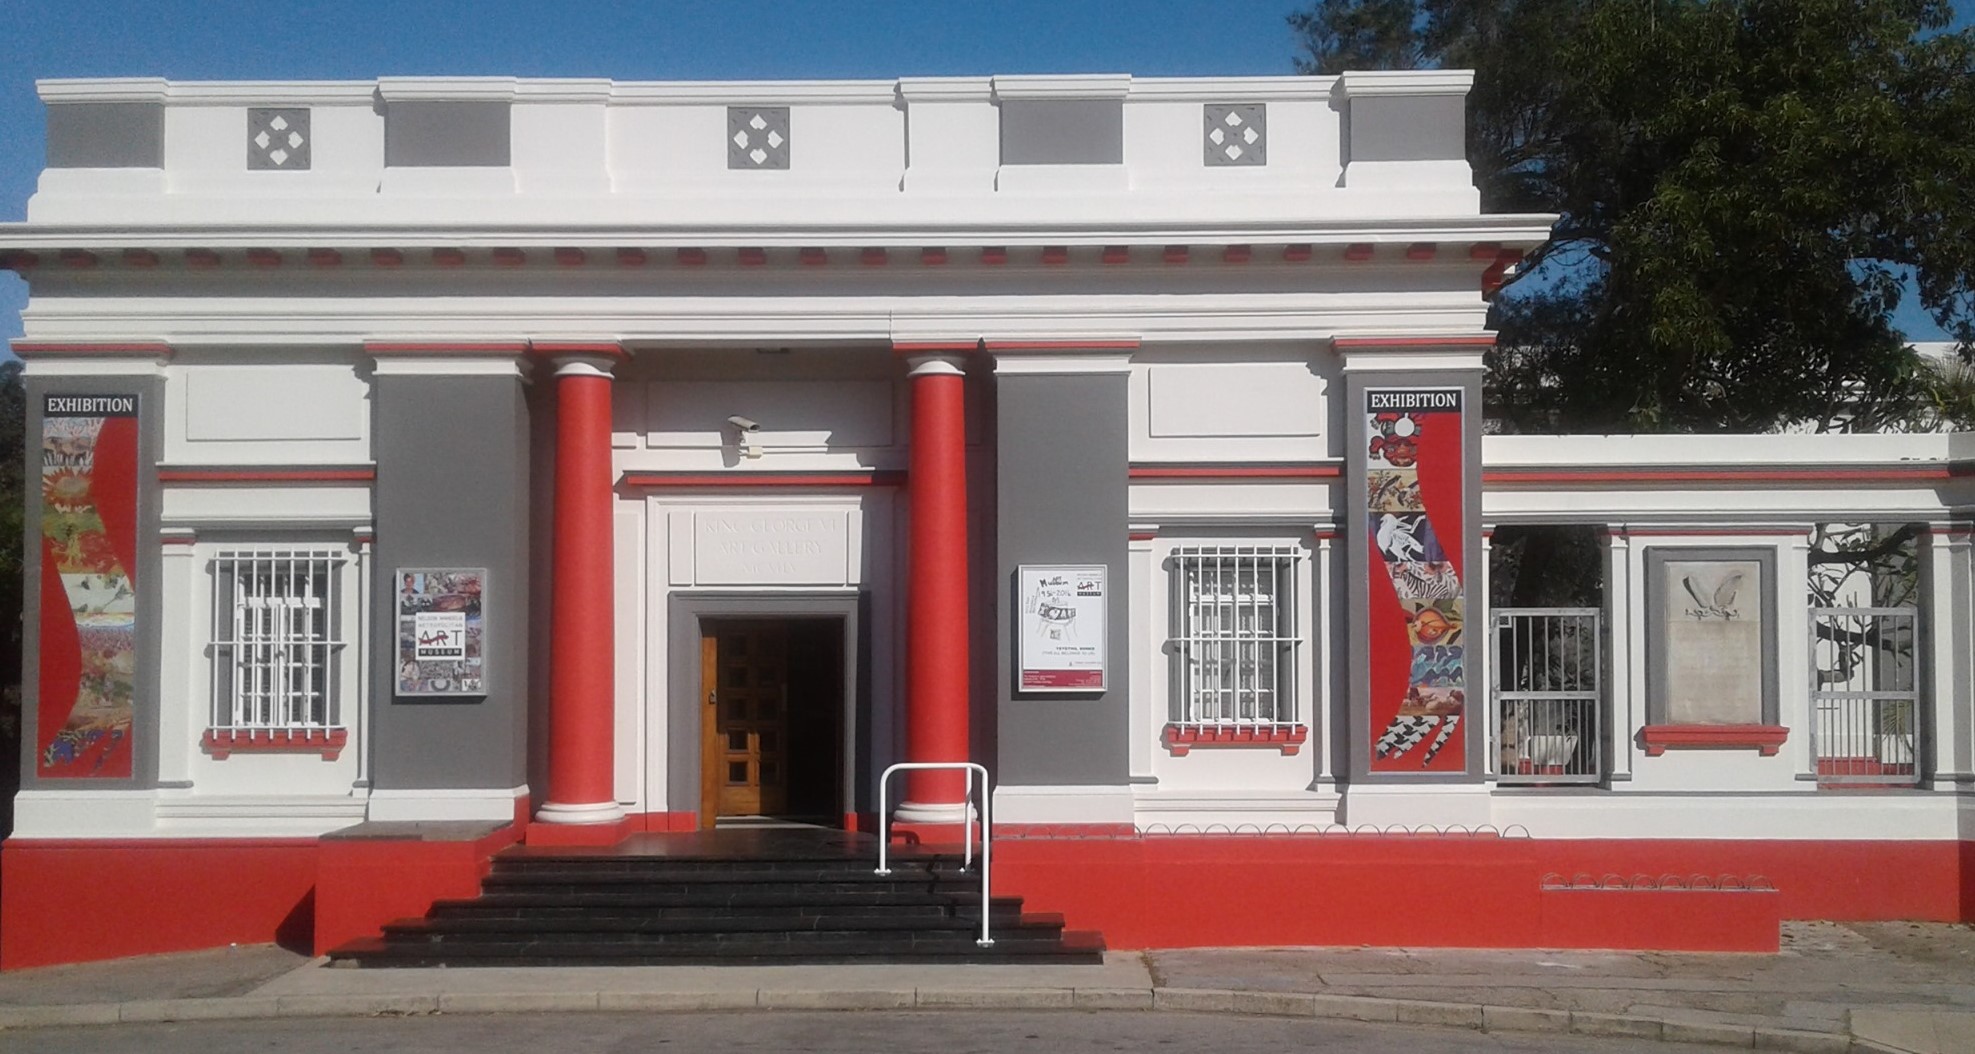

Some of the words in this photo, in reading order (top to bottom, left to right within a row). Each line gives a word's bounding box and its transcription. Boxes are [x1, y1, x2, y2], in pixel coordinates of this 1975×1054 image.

[47, 397, 133, 412] EXHIBITION
[1371, 393, 1457, 408] EXHIBITION
[704, 518, 740, 533] KING
[750, 518, 812, 533] GEORGE
[818, 518, 837, 533] VI
[719, 539, 747, 555] ART
[752, 540, 823, 555] GALLERY
[1077, 581, 1102, 591] ART
[418, 630, 463, 646] ART
